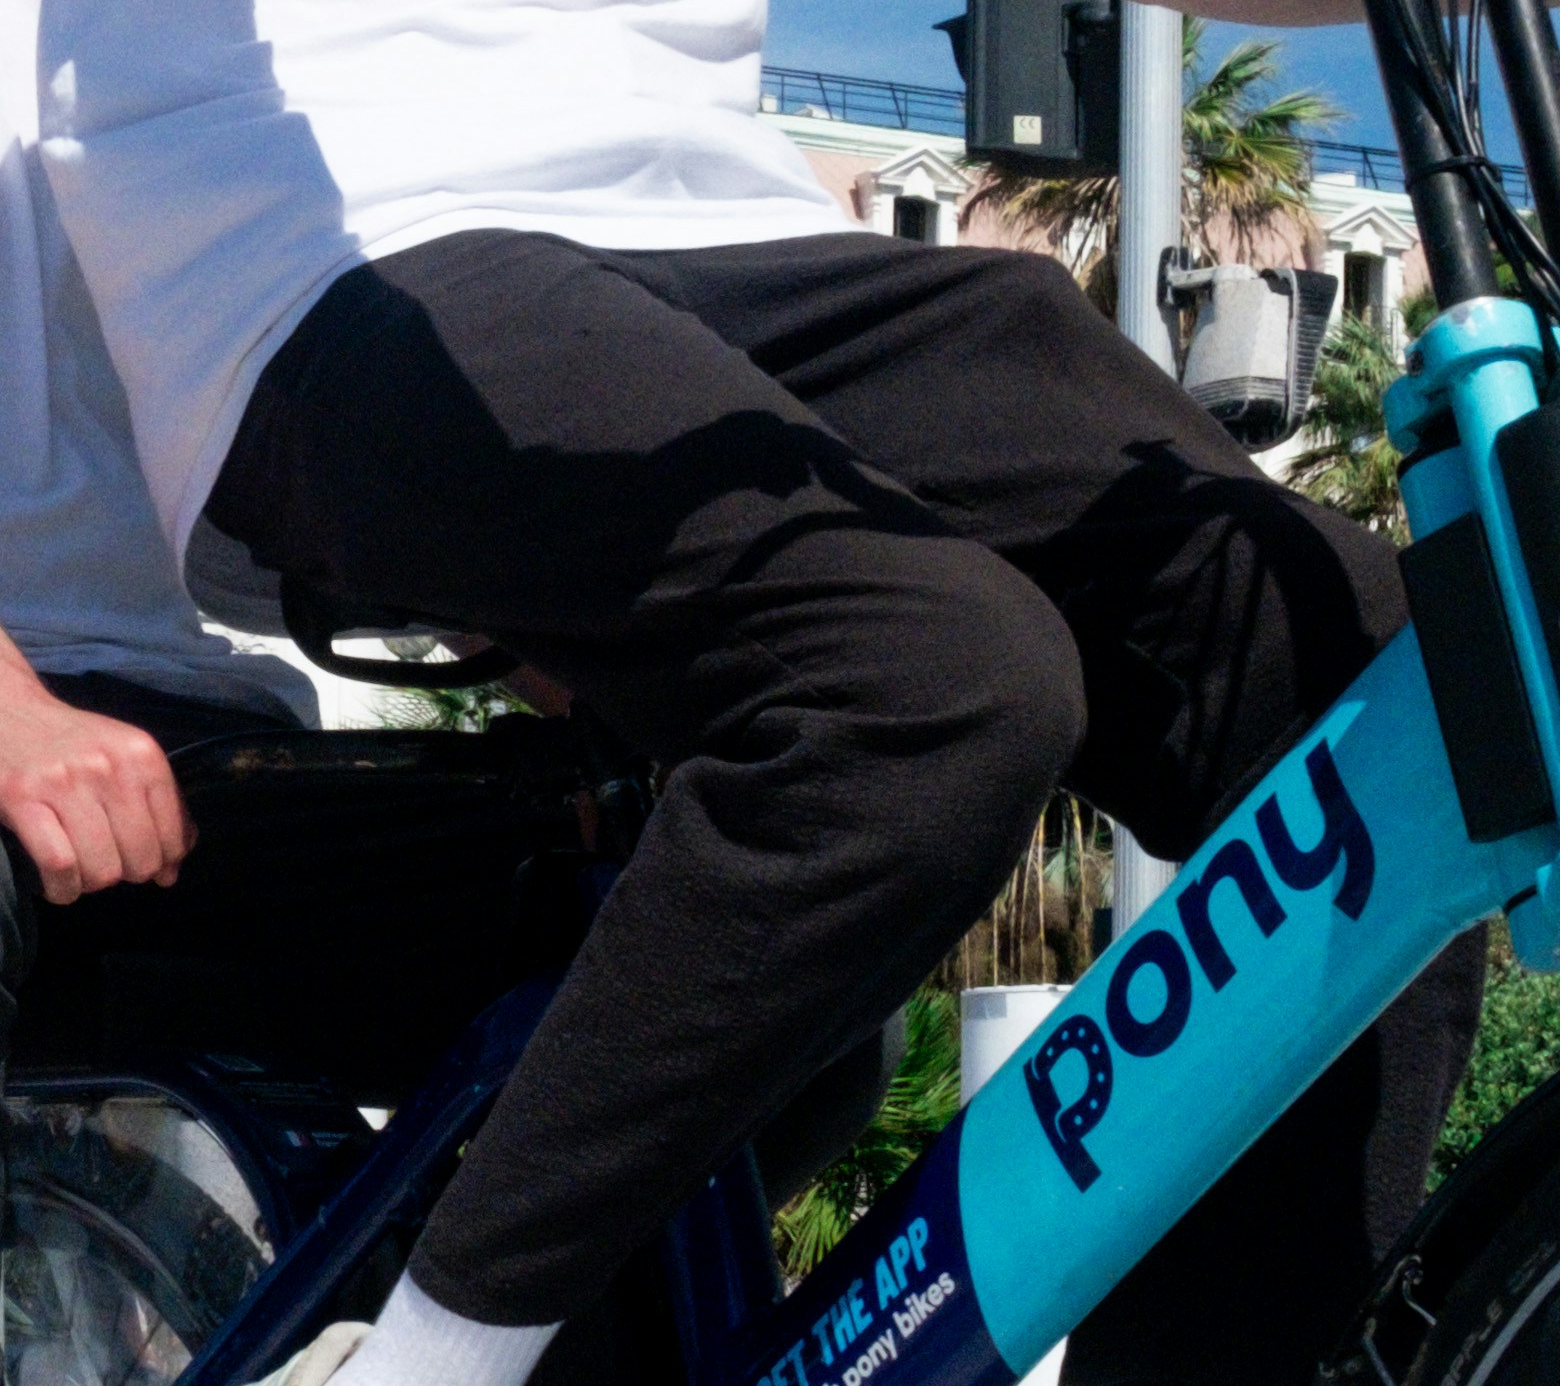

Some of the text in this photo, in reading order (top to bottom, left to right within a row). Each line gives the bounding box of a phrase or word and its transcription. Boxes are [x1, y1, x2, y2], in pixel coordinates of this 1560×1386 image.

[1023, 736, 1377, 1194] pony
[811, 1277, 874, 1368] THE
[874, 1216, 929, 1311] APP
[892, 1271, 956, 1339] bikes
